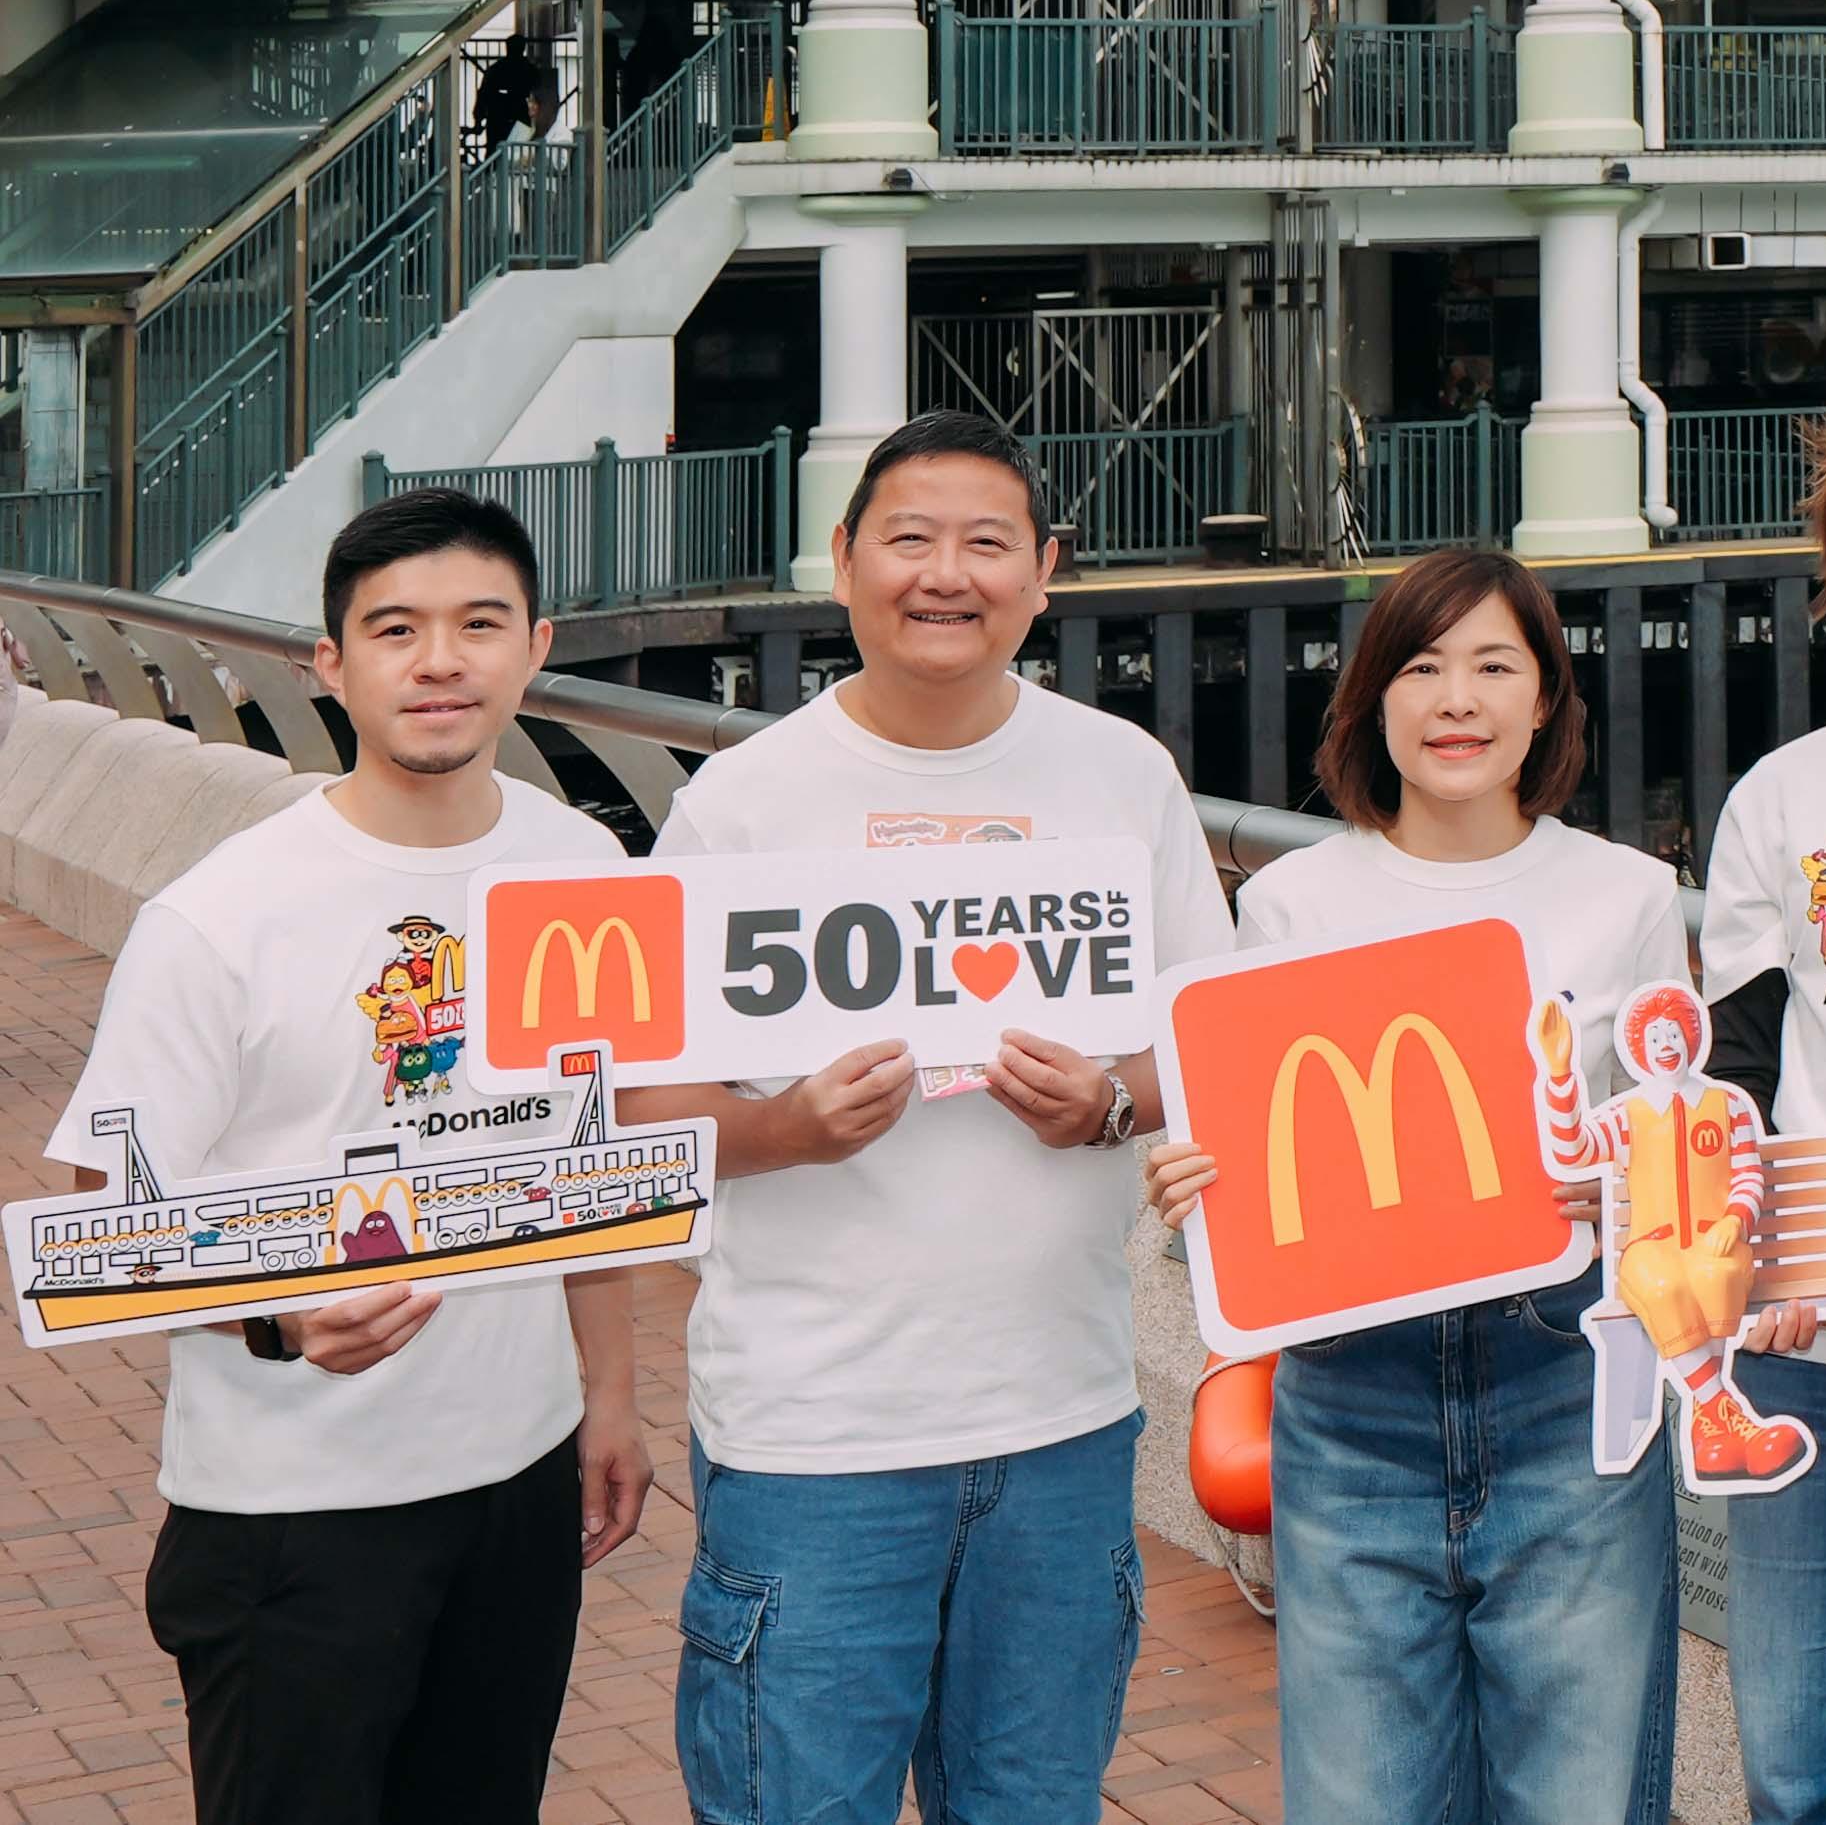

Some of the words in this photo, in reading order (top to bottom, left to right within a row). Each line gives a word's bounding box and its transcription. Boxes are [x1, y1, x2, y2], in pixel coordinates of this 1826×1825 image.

[910, 890, 1101, 940] YEARS
[1107, 890, 1130, 929] OF
[721, 902, 901, 1017] 50
[1679, 1545, 1701, 1568] ent
